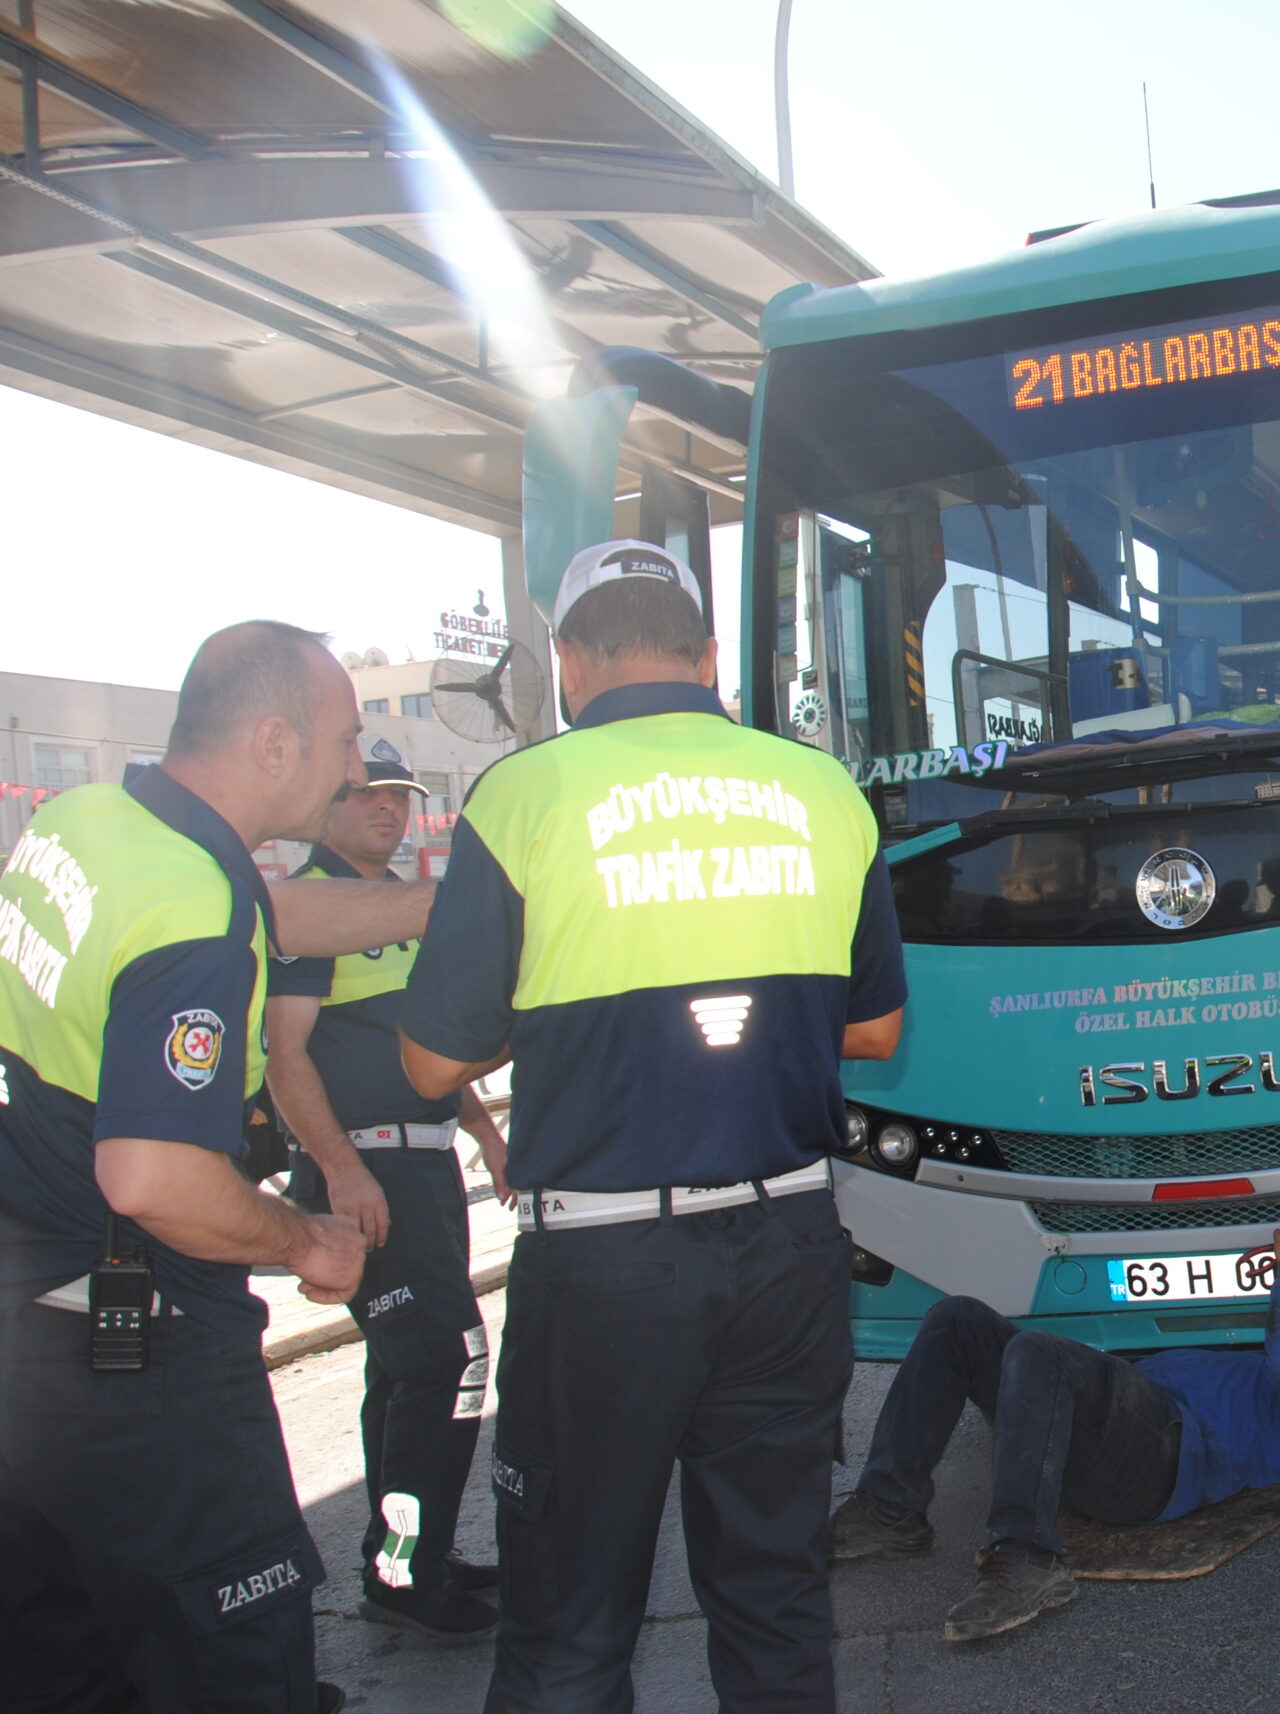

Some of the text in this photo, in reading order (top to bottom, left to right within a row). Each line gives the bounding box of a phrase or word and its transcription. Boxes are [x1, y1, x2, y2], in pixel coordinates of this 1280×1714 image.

[1013, 355, 1064, 411] 21
[631, 561, 675, 578] ZABITA
[838, 740, 1008, 787] LARBAŞI
[587, 772, 812, 850] BÜYÜKŞEHİR
[5, 829, 98, 955] ÜYÜKŞEHİR
[596, 838, 816, 908] TRAFİK ZABITA
[989, 986, 1107, 1018] ŞANLIURFA
[1113, 970, 1257, 1004] BÜYÜKŞEHİR
[1075, 1011, 1130, 1034] ÖZEL
[1135, 1006, 1197, 1029] HALK
[368, 1286, 414, 1318] ZABITA
[1111, 1284, 1126, 1294] TR
[1127, 1262, 1170, 1297] 63
[1186, 1260, 1214, 1295] H
[218, 1559, 301, 1612] ZABITA
